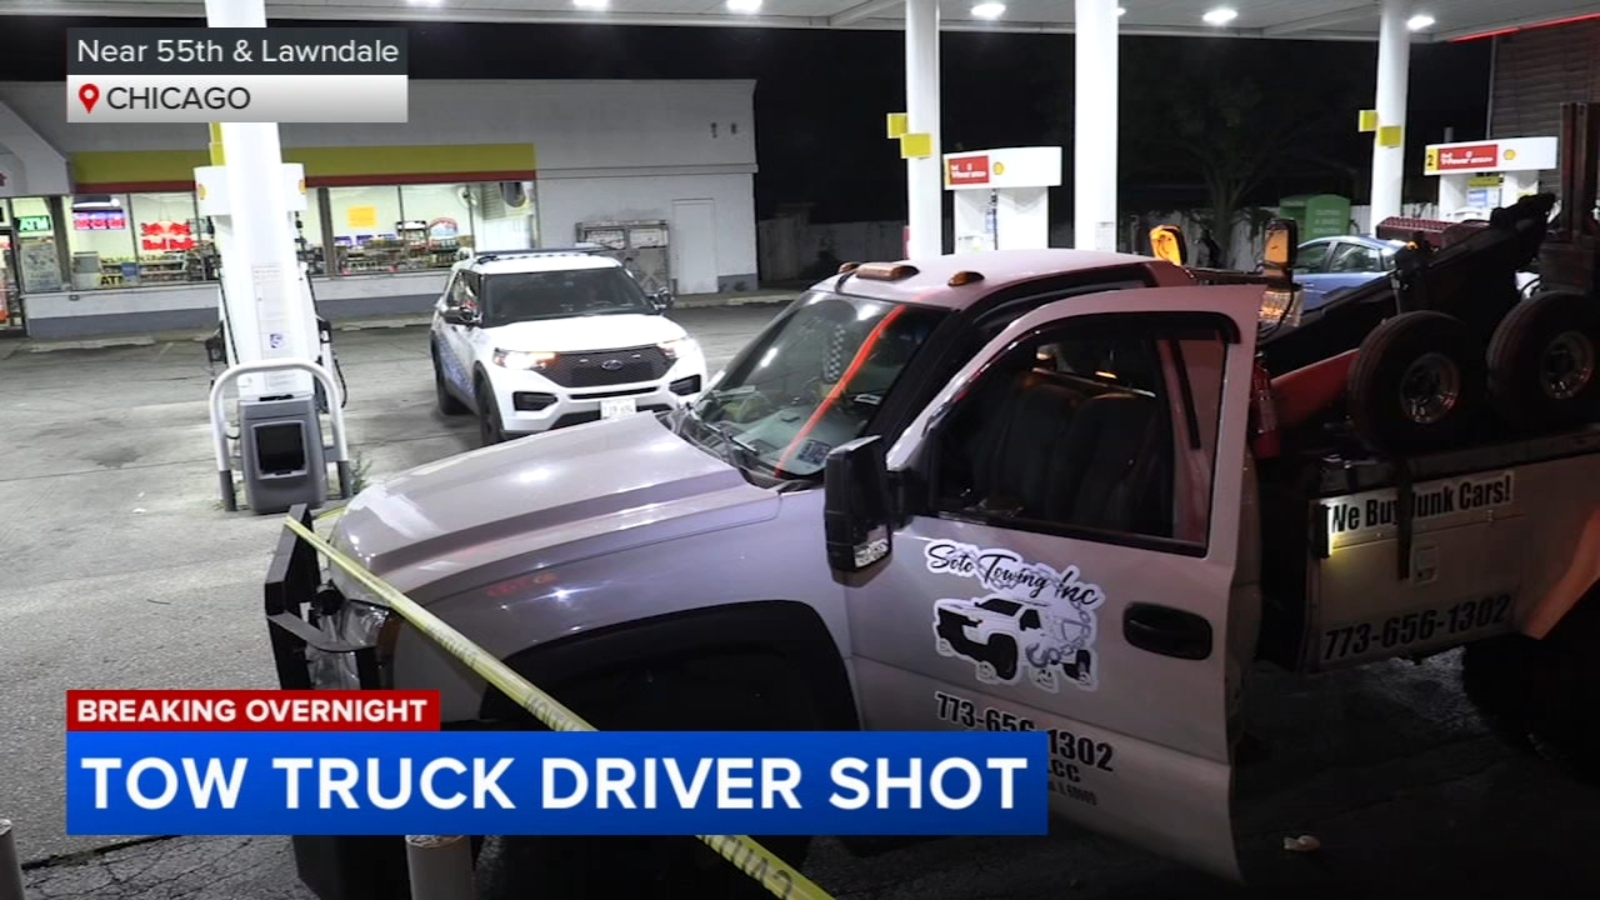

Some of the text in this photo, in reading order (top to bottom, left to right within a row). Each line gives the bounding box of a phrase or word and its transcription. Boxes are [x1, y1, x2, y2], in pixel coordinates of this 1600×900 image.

[19, 217, 48, 230] ATM
[1459, 475, 1511, 509] Cars!
[927, 544, 1099, 605] Soto Towing Inc
[1325, 595, 1511, 660] 773-656-1302
[937, 693, 1114, 772] 773-651302
[1047, 759, 1081, 783] CC
